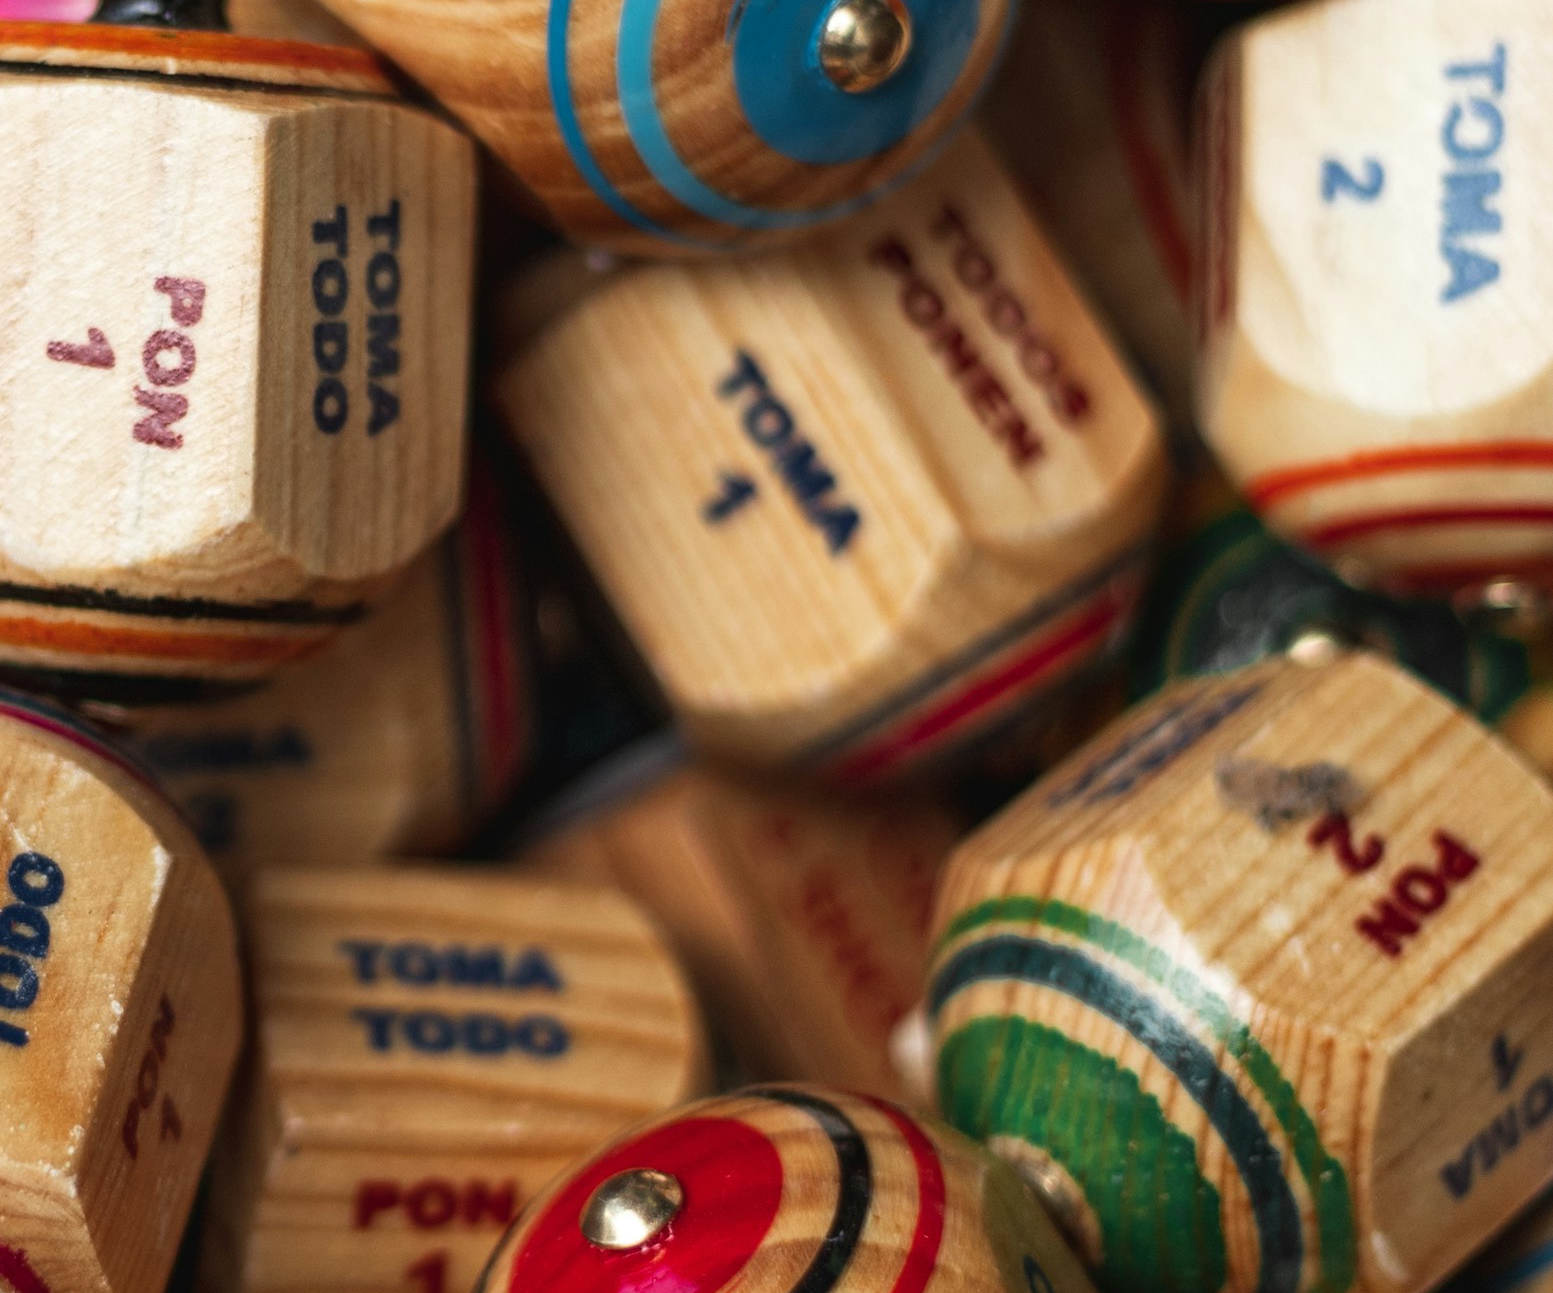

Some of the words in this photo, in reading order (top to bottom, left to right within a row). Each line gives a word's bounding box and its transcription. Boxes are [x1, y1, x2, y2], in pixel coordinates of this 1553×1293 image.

[1321, 158, 1384, 204] 2
[1439, 42, 1507, 304] TOMA
[47, 327, 116, 370] 1
[132, 275, 206, 450] PON
[312, 203, 350, 435] TODO
[365, 198, 401, 437] TOMA
[873, 236, 1045, 468] PONEN
[928, 201, 1093, 428] TODOS
[702, 468, 756, 524] 1
[718, 346, 862, 556] TOMA
[1308, 811, 1385, 877] 2
[1354, 827, 1482, 960] PON
[340, 938, 566, 994] TOMA
[353, 1006, 570, 1060] TODO
[1439, 1074, 1553, 1202] OMA
[355, 1178, 518, 1232] PON
